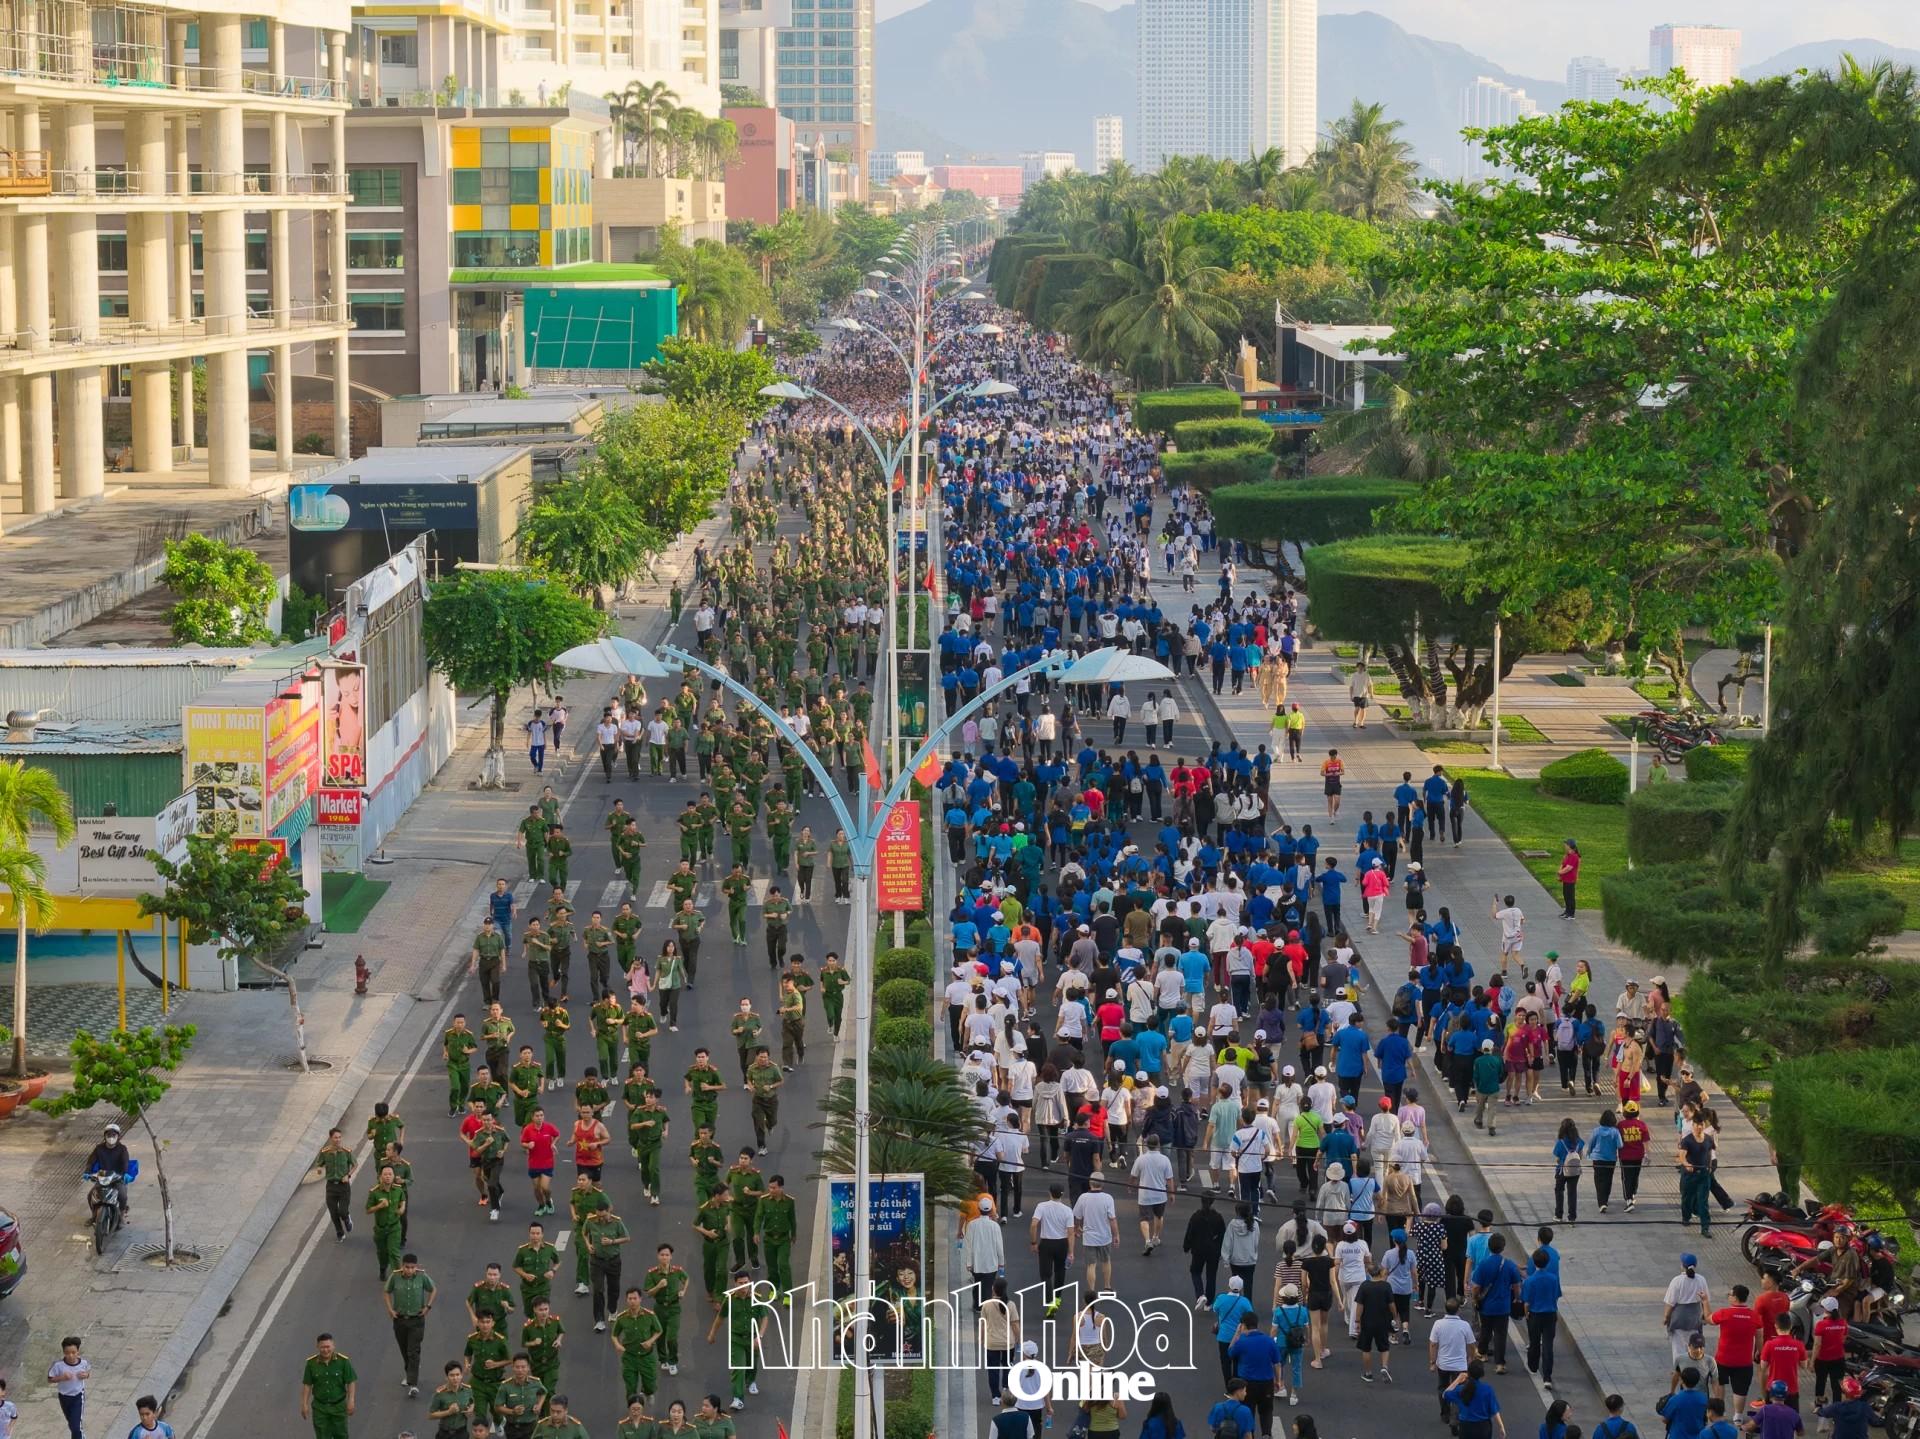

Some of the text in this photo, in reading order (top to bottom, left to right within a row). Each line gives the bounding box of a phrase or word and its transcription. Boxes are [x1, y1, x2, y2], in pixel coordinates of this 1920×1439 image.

[191, 713, 262, 730] MINI MART
[328, 753, 362, 778] SPA
[320, 793, 358, 814] Market
[92, 830, 141, 843] Nha Trang
[80, 844, 149, 860] Best Gift Sho
[891, 1199, 912, 1210] thật
[891, 1211, 907, 1219] tác
